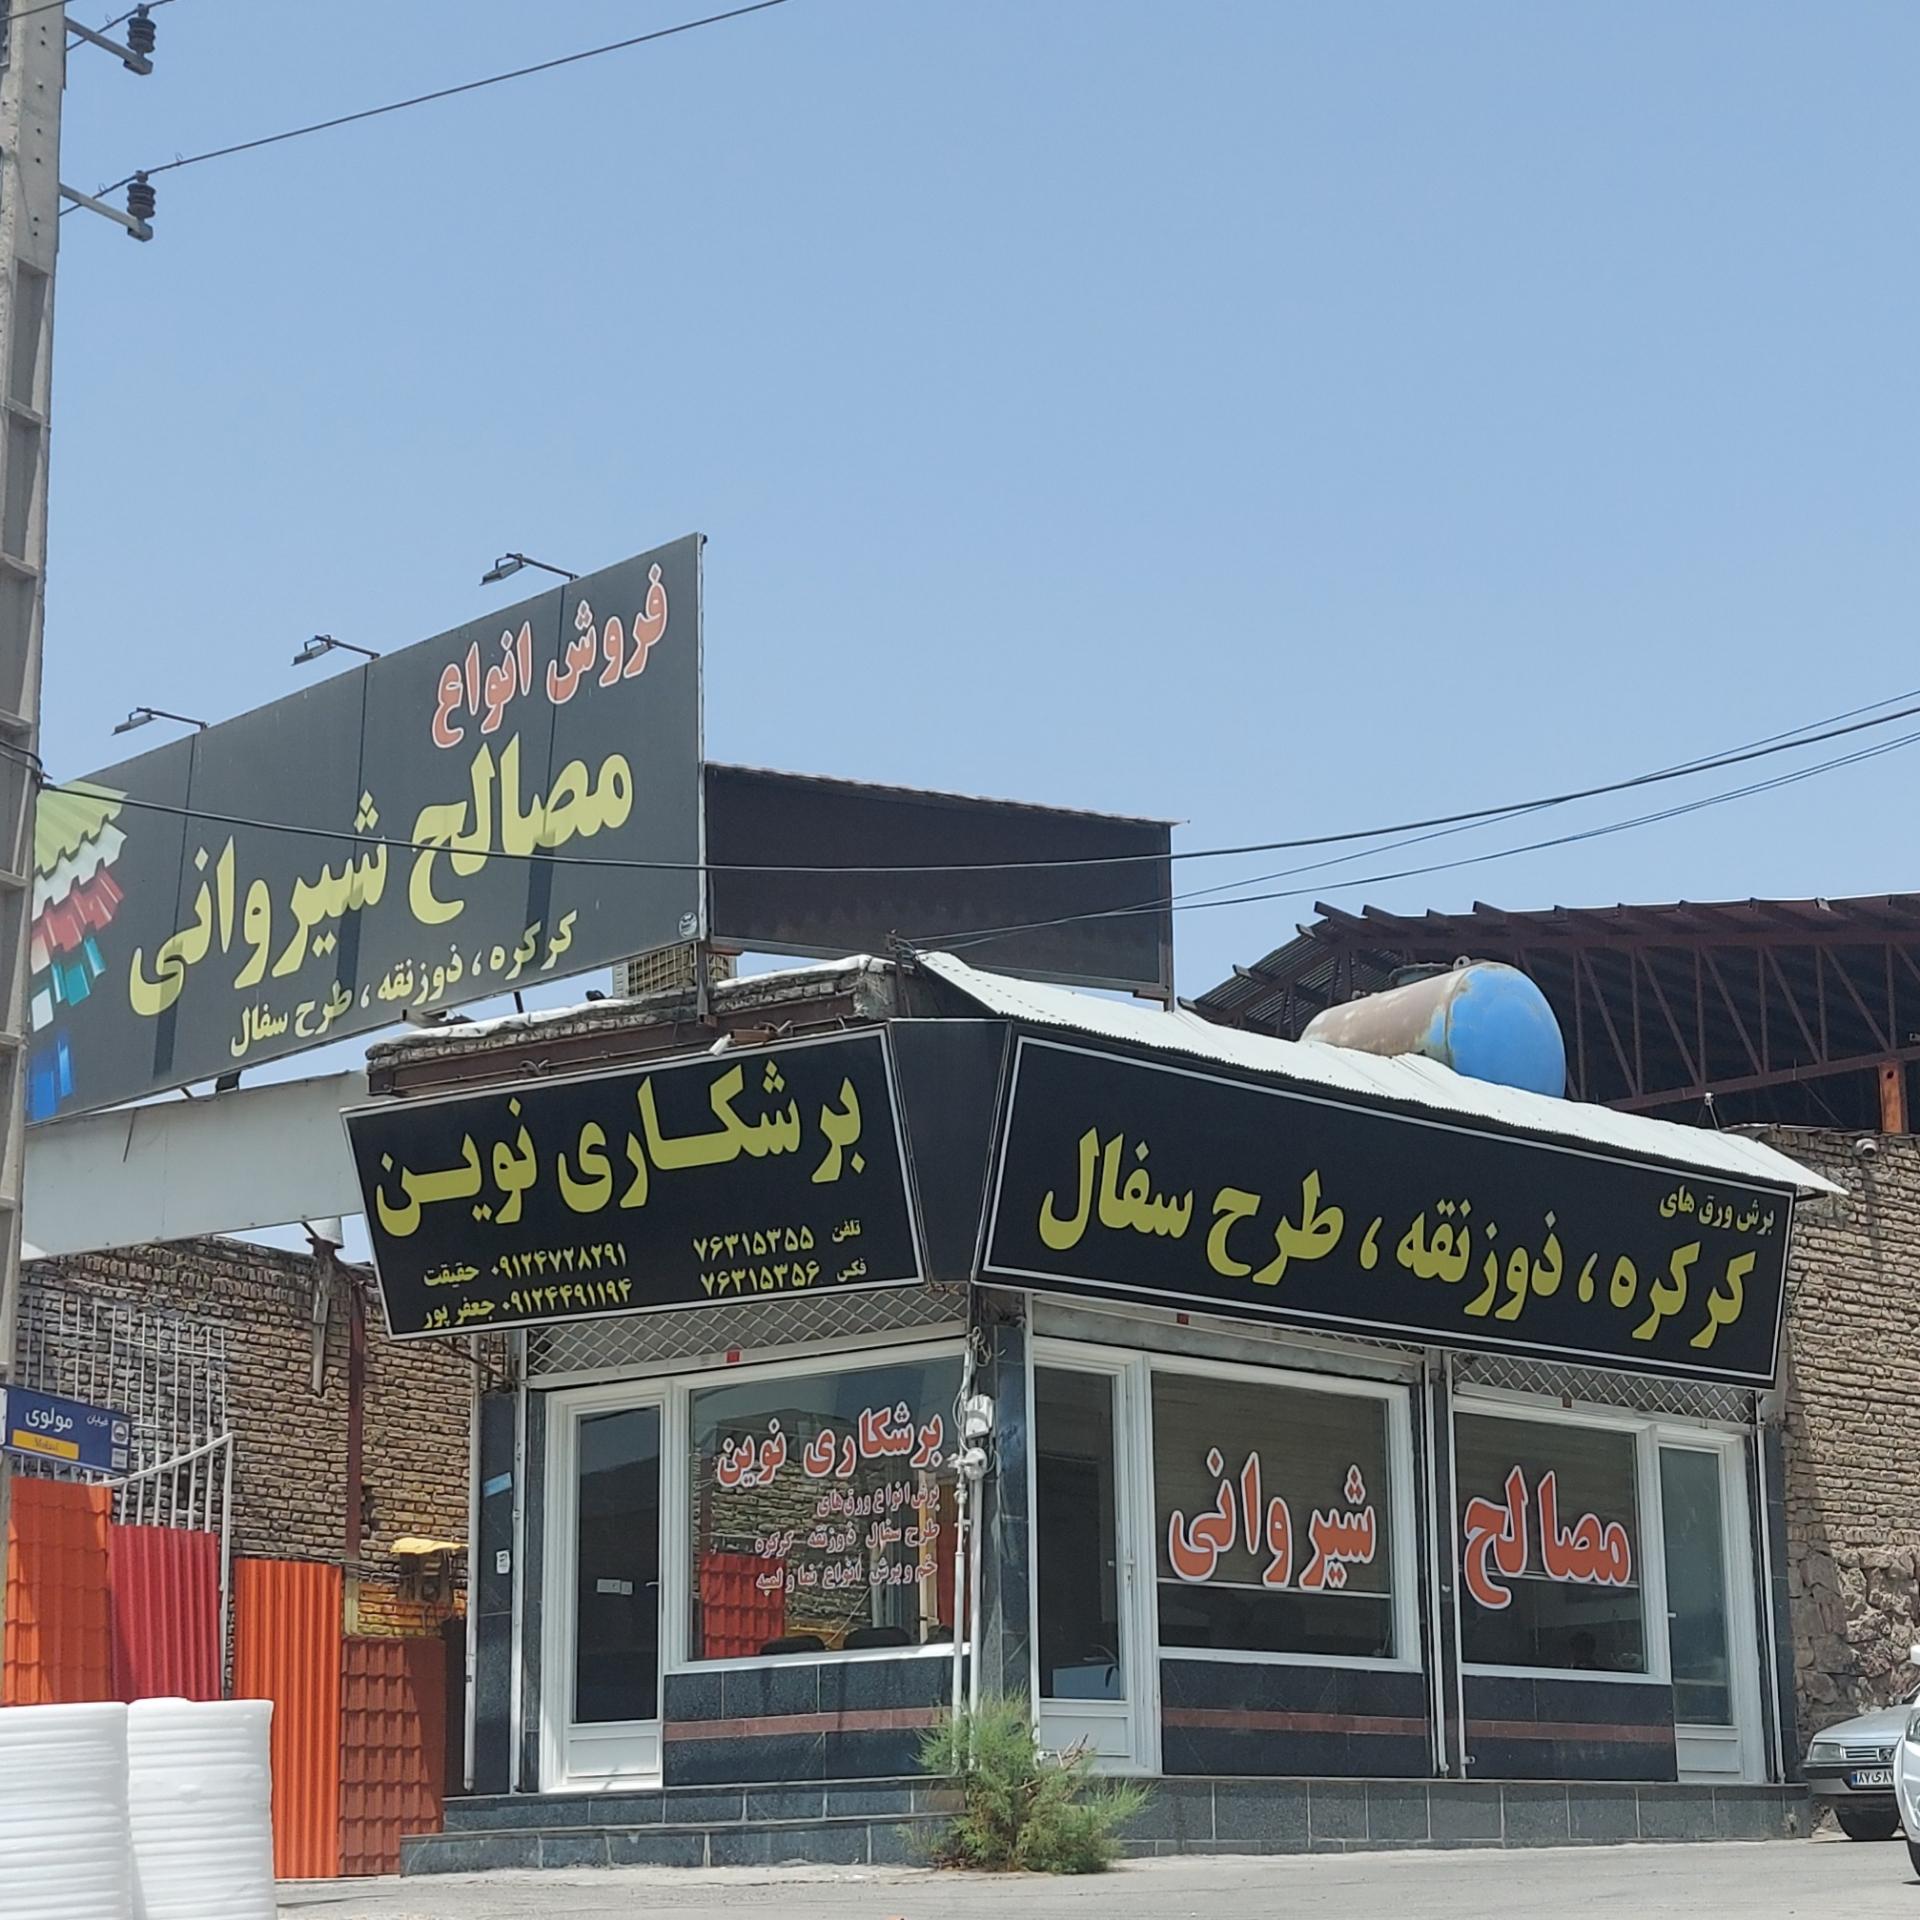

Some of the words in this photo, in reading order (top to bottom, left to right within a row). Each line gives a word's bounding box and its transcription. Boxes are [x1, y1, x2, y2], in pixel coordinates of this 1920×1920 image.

[547, 564, 668, 705] فروش
[431, 621, 533, 748] انواع
[408, 733, 634, 925] مصالح
[129, 790, 388, 1017] شیروانی
[294, 979, 353, 1037] طرح
[230, 1003, 289, 1058] سفال
[556, 1059, 867, 1213] برشکاری
[375, 1097, 537, 1238] نوین
[1038, 1126, 1194, 1252] سفال
[1659, 1184, 1695, 1218] های
[1205, 1169, 1345, 1286] طرح
[1698, 1194, 1733, 1229] ورق
[1737, 1199, 1775, 1236] برش
[693, 1225, 815, 1262] ۷۶۳۱۵۳۵۵
[831, 1219, 862, 1243] تلفن
[423, 1262, 480, 1288] حقیقت
[700, 1260, 820, 1297] ۷۶۳۱۵۳۵۶
[836, 1257, 868, 1283] فکس
[25, 1407, 73, 1433] مولوی
[717, 1417, 787, 1487] نوین
[803, 1400, 944, 1478] برشکاری
[872, 1480, 911, 1514] انواع
[911, 1481, 941, 1512] برش
[865, 1518, 902, 1550] سفال
[904, 1517, 941, 1547] طرح
[1169, 1447, 1377, 1590] شیروانی
[1463, 1464, 1632, 1609] مصالح
[754, 1530, 795, 1558] کرکره
[807, 1521, 857, 1554] ذوزنقه
[785, 1574, 795, 1593] و
[797, 1562, 818, 1586] نما
[822, 1552, 863, 1590] انواع
[868, 1557, 902, 1586] برش
[902, 1564, 913, 1584] و
[915, 1552, 938, 1583] خم
